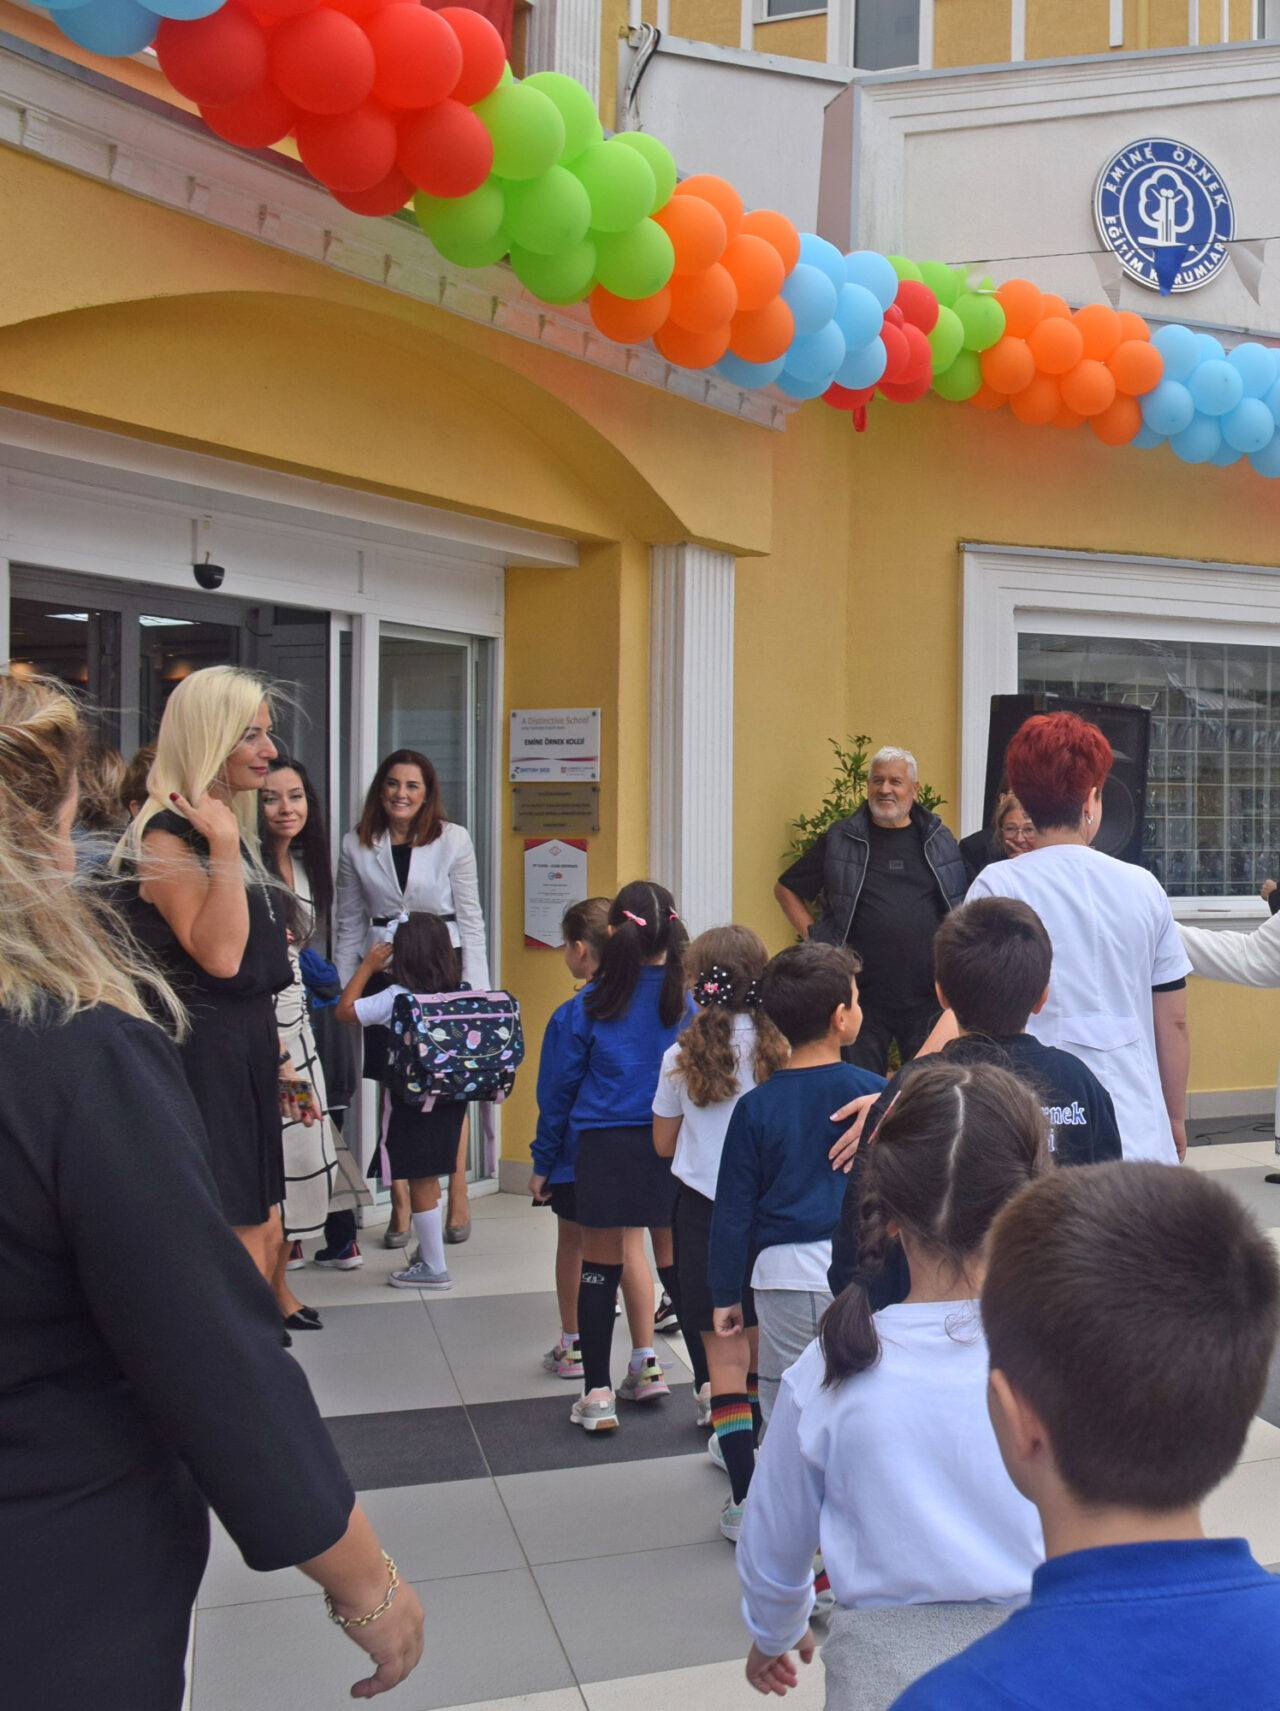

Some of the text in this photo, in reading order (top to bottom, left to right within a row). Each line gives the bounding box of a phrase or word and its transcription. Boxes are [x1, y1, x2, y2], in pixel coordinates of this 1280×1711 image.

[1104, 146, 1230, 206] EMİNE ÖRNEK
[1150, 233, 1228, 285] KRUMLARI
[566, 715, 590, 725] School
[524, 736, 585, 746] EMİNE ÖRNEK KOLEJİ
